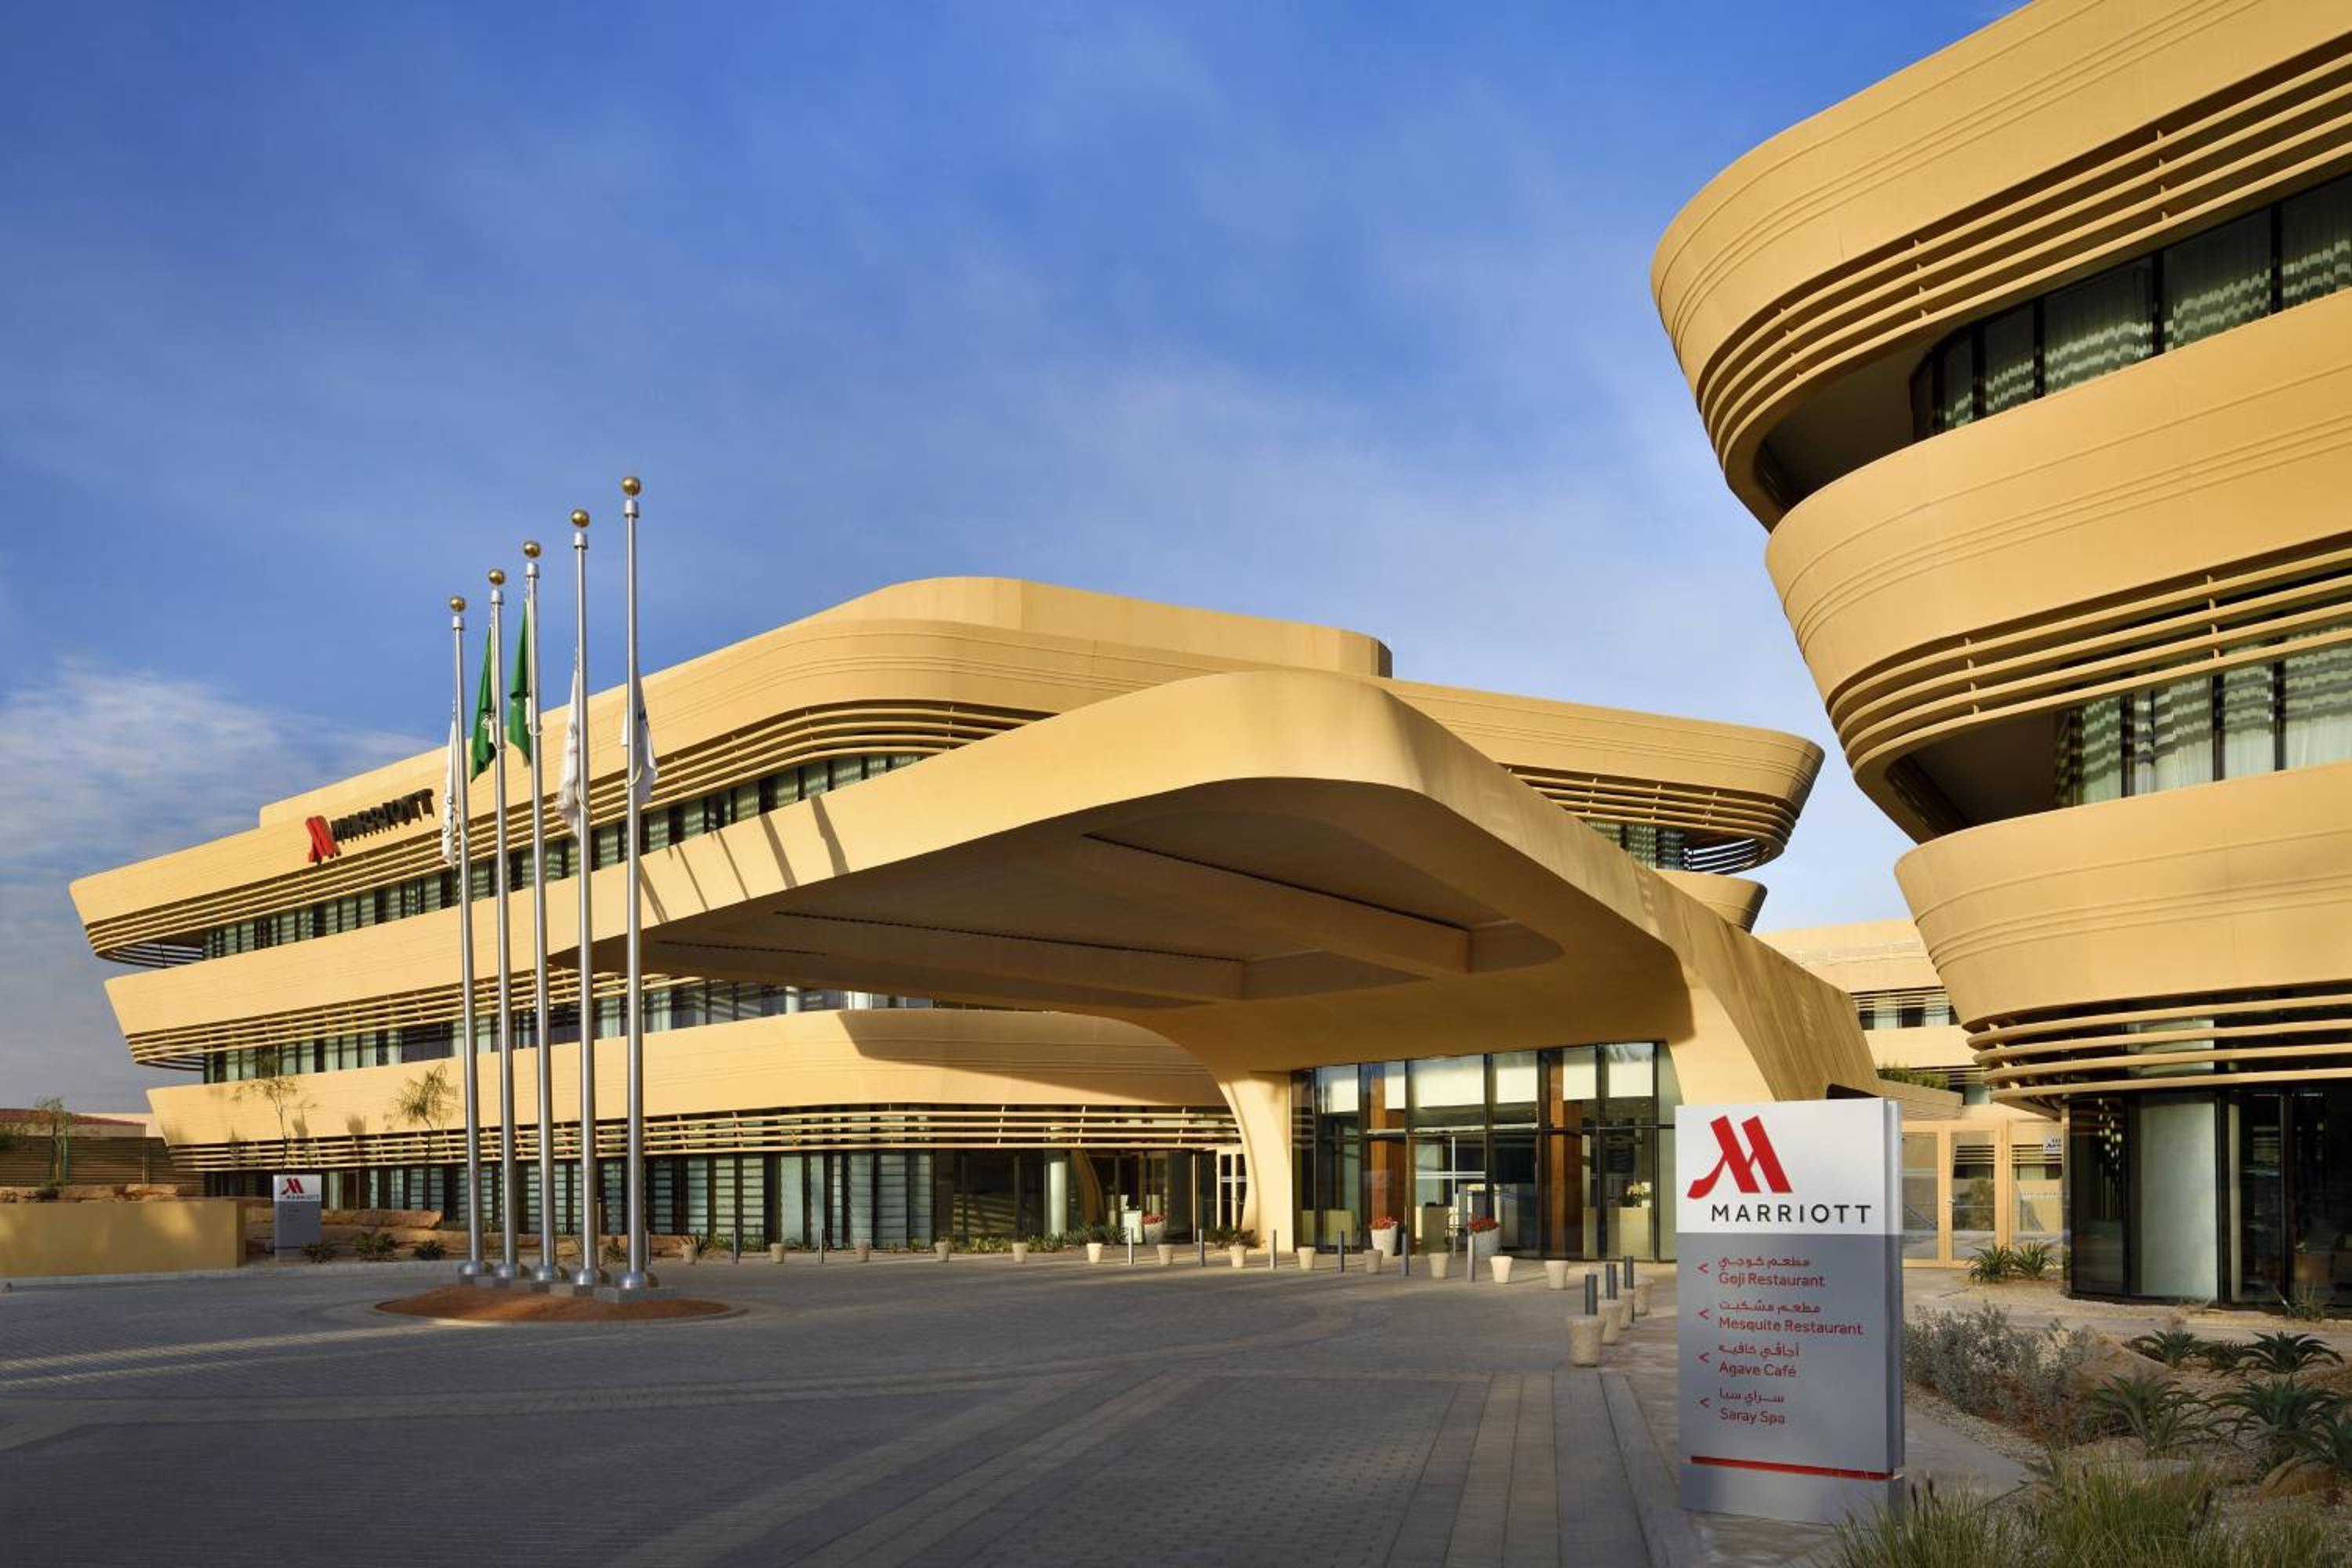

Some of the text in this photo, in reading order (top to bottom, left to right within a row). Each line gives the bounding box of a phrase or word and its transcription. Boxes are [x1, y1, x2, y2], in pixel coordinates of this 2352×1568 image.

[1711, 1203, 1871, 1224] MARRIOTT
[1767, 1256, 1810, 1269] مطعم
[1719, 1272, 1825, 1287] Goji Restaurant
[1777, 1301, 1821, 1315] مطعم
[1719, 1316, 1864, 1335] Mesquite Restaurant
[1719, 1361, 1796, 1377] Agave Café
[1719, 1407, 1785, 1425] Saray Spa
